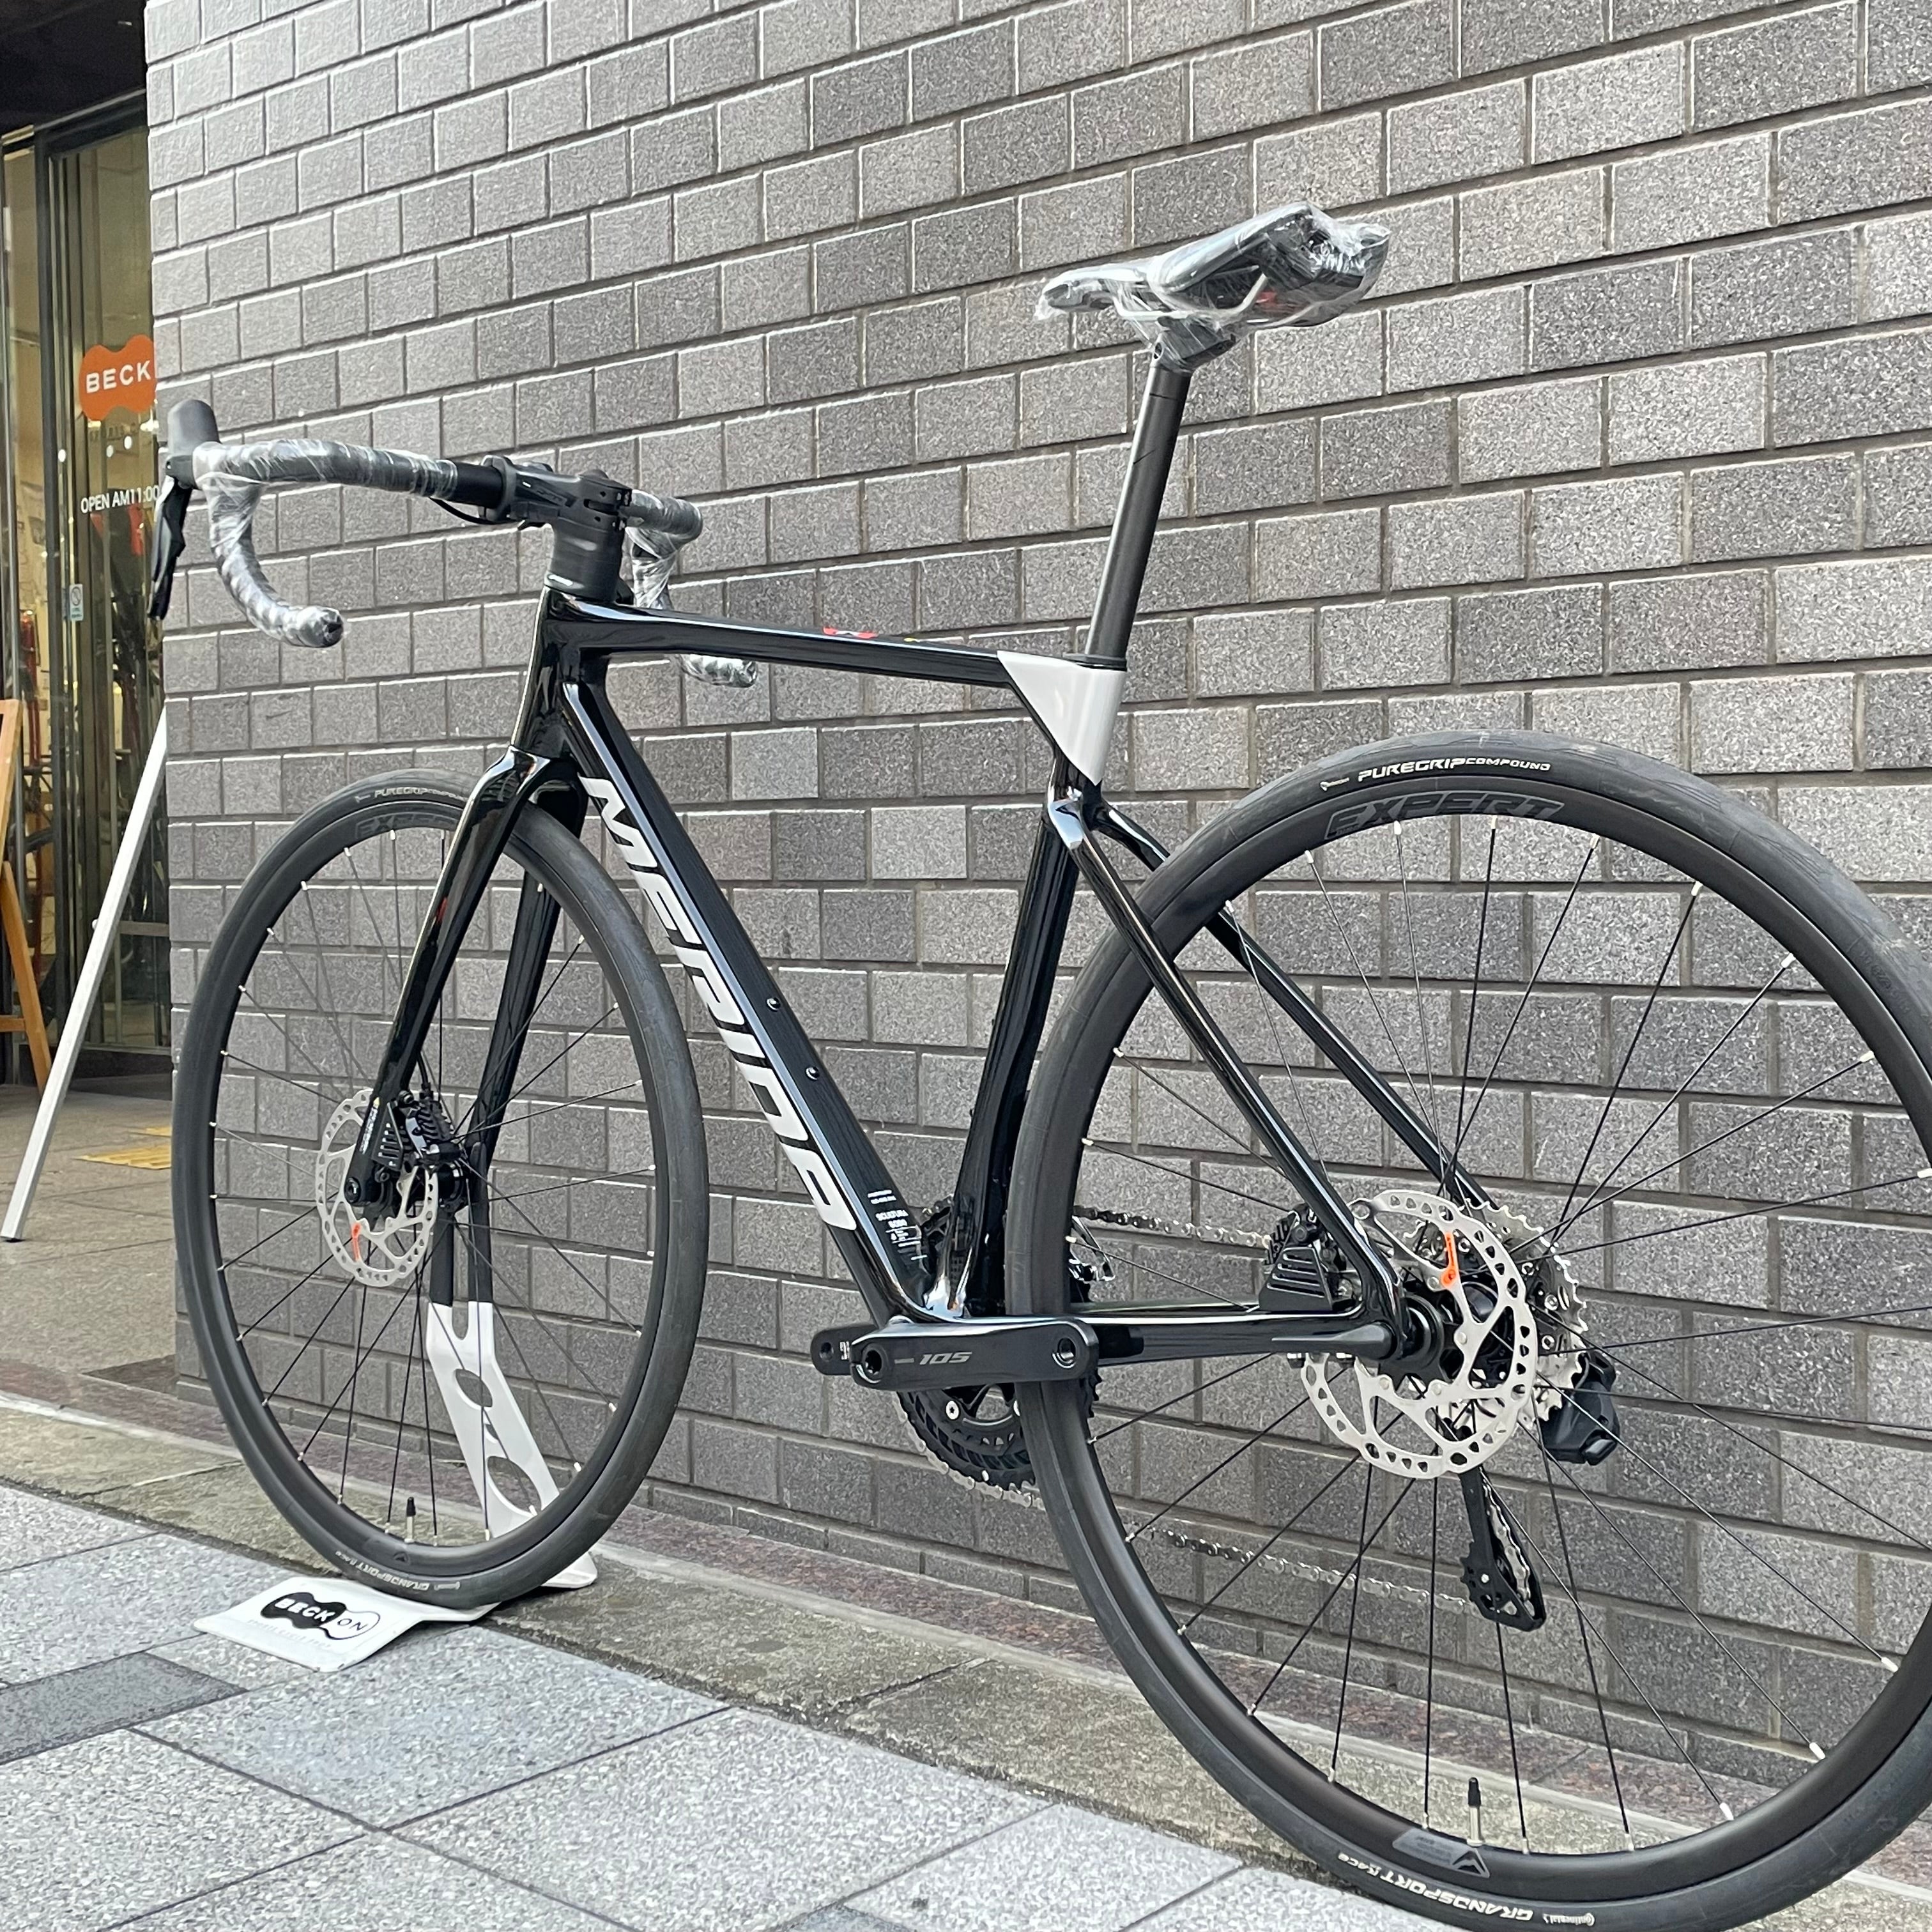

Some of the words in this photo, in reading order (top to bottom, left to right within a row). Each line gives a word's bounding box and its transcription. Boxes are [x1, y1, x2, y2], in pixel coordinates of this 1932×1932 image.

[86, 360, 151, 394] BECK
[81, 493, 109, 514] OPEN
[1328, 792, 1564, 837] EXPERT
[578, 772, 856, 1230] MERIDA
[919, 1352, 972, 1365] 105
[275, 1598, 336, 1622] BECK
[337, 1618, 368, 1631] ON
